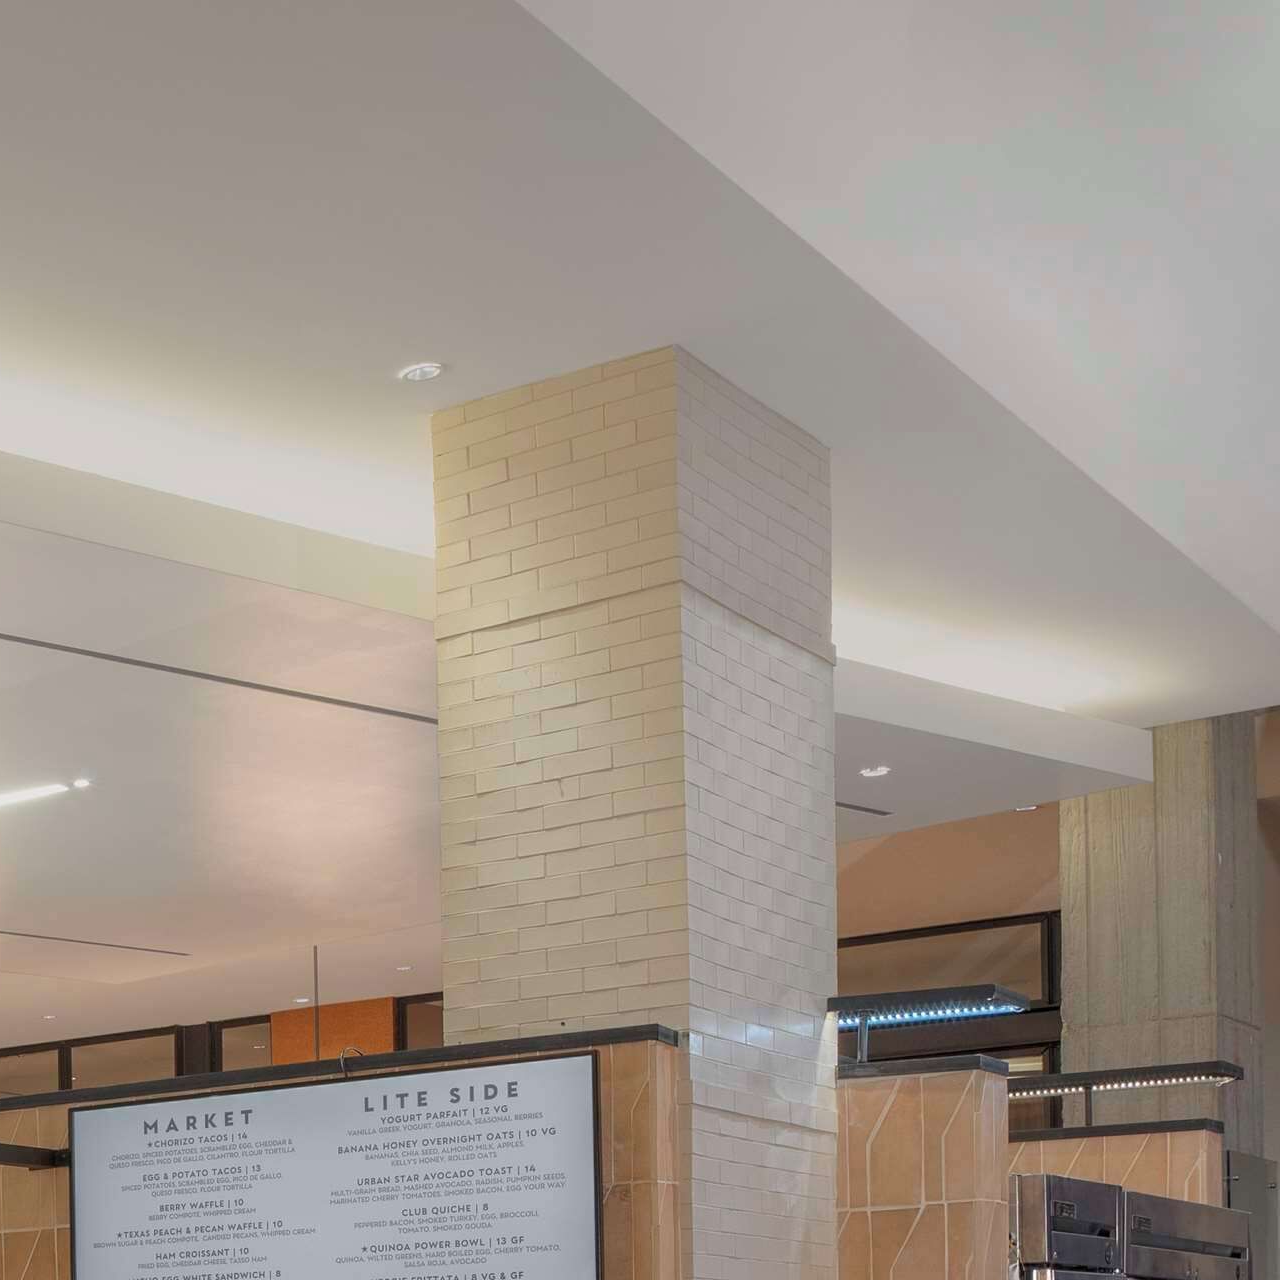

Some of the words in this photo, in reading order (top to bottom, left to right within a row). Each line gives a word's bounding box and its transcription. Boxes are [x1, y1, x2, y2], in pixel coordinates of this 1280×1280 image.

[363, 1090, 429, 1112] LITE
[449, 1080, 519, 1104] SIDE
[142, 1108, 254, 1135] MARKET
[379, 1113, 422, 1124] YOGURT
[425, 1108, 468, 1120] PARFAIT
[479, 1106, 489, 1115] 12
[493, 1104, 508, 1113] VG
[154, 1137, 194, 1148] CHORIZO
[198, 1133, 228, 1143] TACOS
[237, 1131, 247, 1140] 14
[337, 1143, 378, 1154] BANANA
[382, 1139, 417, 1150] HONEY
[421, 1133, 482, 1146] OVERNIGHT
[486, 1130, 514, 1141] OATS
[525, 1128, 537, 1137] 10
[541, 1126, 556, 1136] VG
[142, 1173, 160, 1182] EGG
[162, 1172, 168, 1180] &
[171, 1168, 208, 1179] POTATO
[211, 1165, 241, 1175] TACOS
[251, 1164, 260, 1172] 13
[356, 1175, 390, 1186] URBAN
[394, 1173, 418, 1183] STAR
[423, 1168, 475, 1181] AVOCADO
[479, 1165, 513, 1176] TOAST
[524, 1163, 536, 1172] 14
[159, 1203, 186, 1212] BERRY
[189, 1199, 224, 1210] WAFFLE
[233, 1198, 244, 1206] 10
[401, 1207, 427, 1217] CLUB
[431, 1204, 471, 1214] QUICHE
[482, 1203, 489, 1211] 8
[123, 1229, 150, 1238] TEXAS
[153, 1227, 182, 1236] PEACH
[185, 1226, 191, 1234] &
[194, 1224, 224, 1233] PECAN
[227, 1221, 262, 1231] WAFFLE
[272, 1220, 283, 1228] 10
[369, 1242, 411, 1253] QUINOA
[414, 1240, 450, 1250] POWER
[455, 1238, 485, 1247] BOWL
[496, 1236, 506, 1245] 13
[510, 1235, 525, 1244] GF
[155, 1251, 175, 1260] HAM
[178, 1248, 229, 1259] CROISSANT
[239, 1247, 249, 1255] 10
[214, 1270, 265, 1280] SANDWICH
[275, 1269, 281, 1277] 8
[471, 1273, 477, 1280] 8
[480, 1272, 496, 1280] VG
[499, 1271, 506, 1280] &
[510, 1270, 524, 1279] GF
